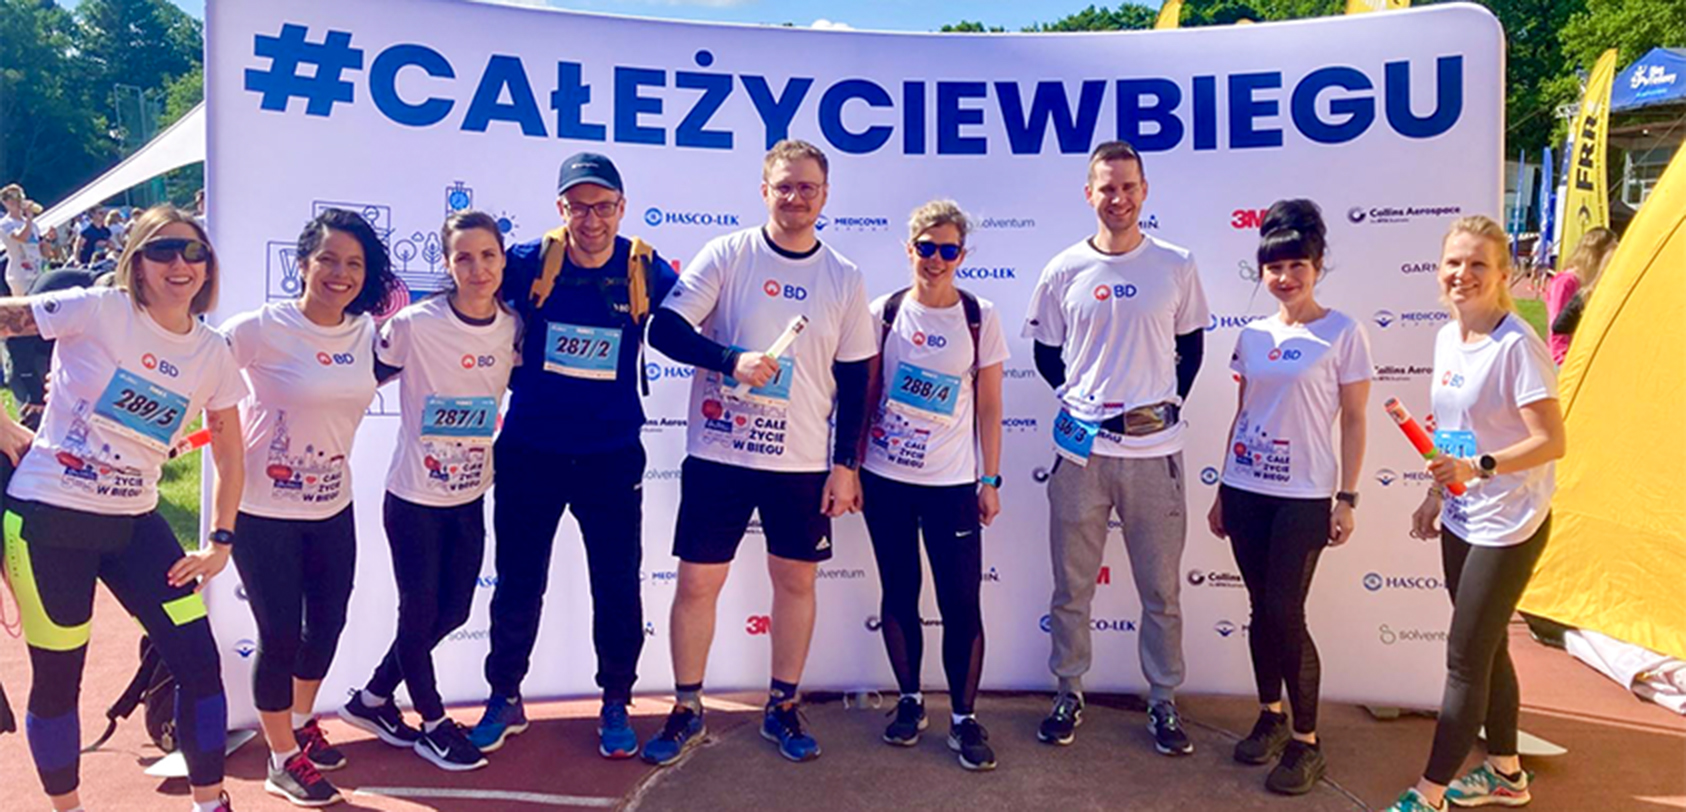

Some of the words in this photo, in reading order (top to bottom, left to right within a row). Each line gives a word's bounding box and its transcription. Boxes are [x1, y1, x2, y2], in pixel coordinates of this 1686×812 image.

[244, 23, 1463, 155] #CAŁEŻYCIEWBIEGU
[666, 212, 739, 226] HASCO-LEK
[1369, 207, 1404, 217] Collins
[1406, 207, 1460, 216] Aerospace
[835, 218, 888, 226] MEDICOVER
[1231, 210, 1269, 229] 3M
[955, 267, 1015, 279] ASCO-LEK
[783, 284, 807, 300] BD
[1113, 284, 1137, 298] BD
[1401, 312, 1449, 321] MEDICOV
[556, 336, 612, 358] 287/2
[927, 335, 947, 348] BD
[333, 353, 354, 365] BD
[477, 356, 495, 367] BD
[1283, 349, 1302, 361] BD
[159, 360, 179, 378] BD
[901, 375, 951, 403] 288/4
[112, 388, 178, 426] 289/5
[434, 408, 487, 427] 287/1
[733, 440, 745, 450] W
[747, 441, 785, 455] BIEGU
[1208, 571, 1241, 582] Collins
[1385, 576, 1447, 590] HASCO-
[1089, 618, 1136, 632] CO-LEK
[1399, 629, 1449, 642] solvent
